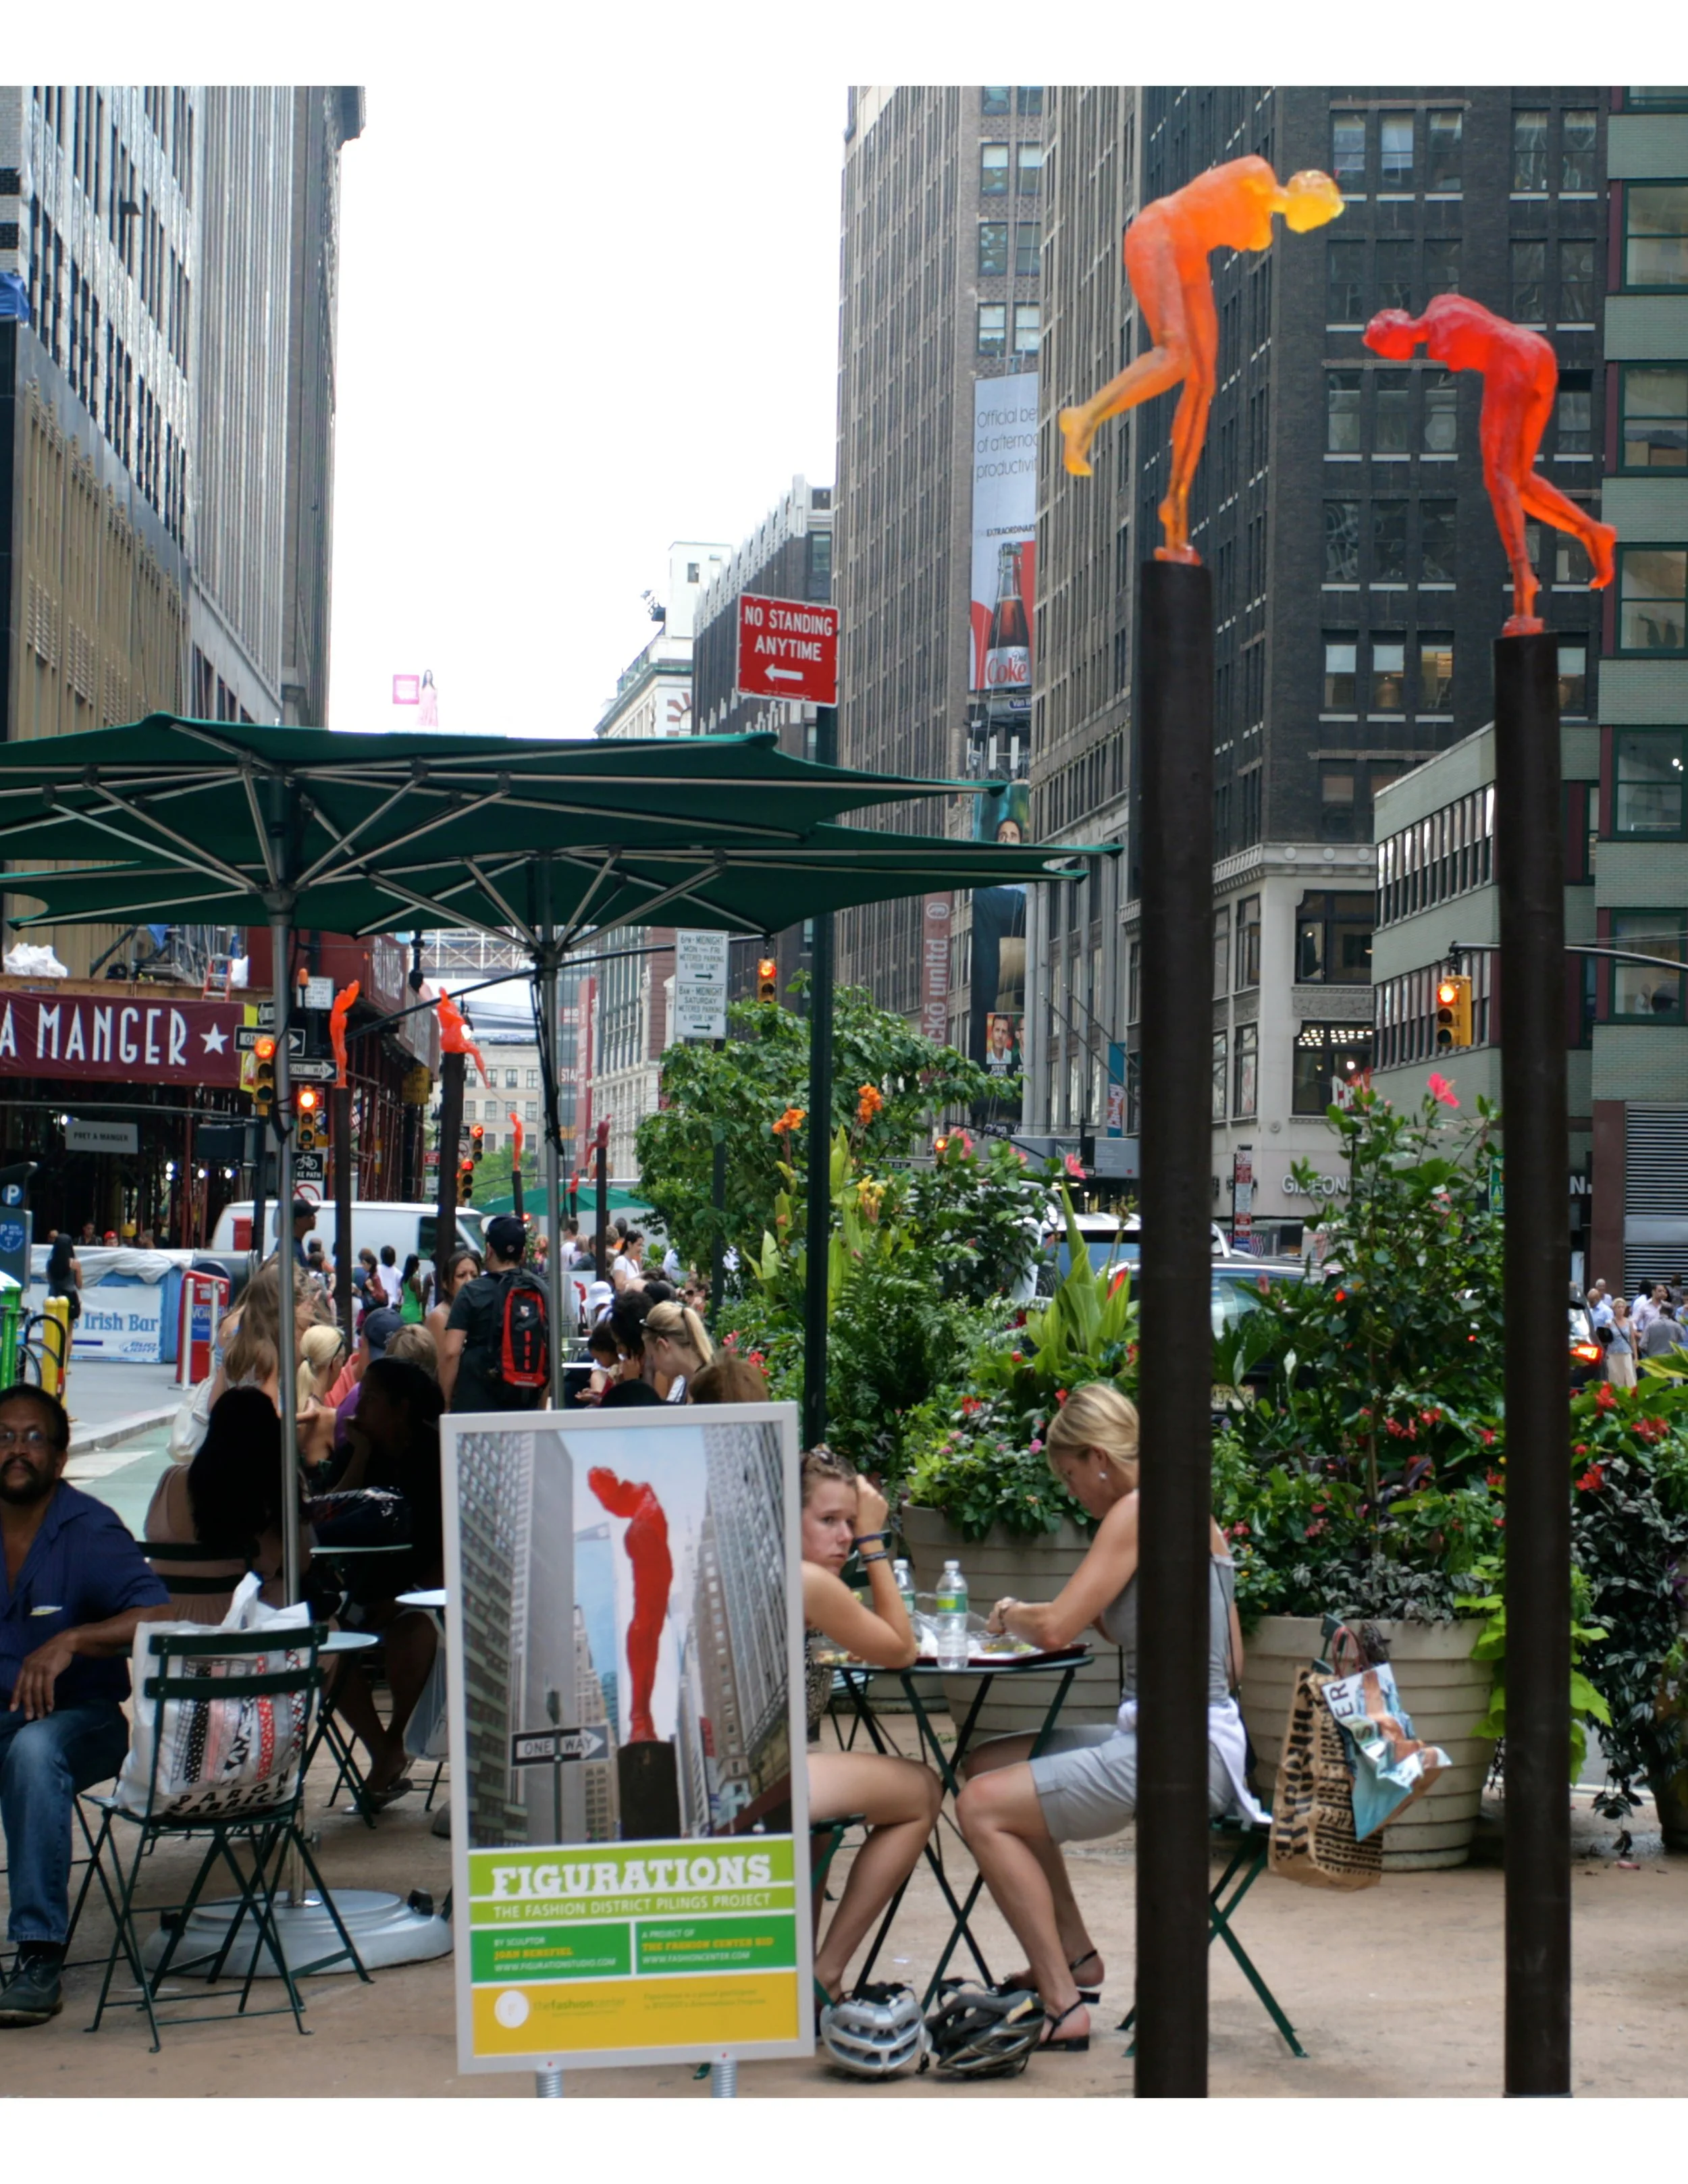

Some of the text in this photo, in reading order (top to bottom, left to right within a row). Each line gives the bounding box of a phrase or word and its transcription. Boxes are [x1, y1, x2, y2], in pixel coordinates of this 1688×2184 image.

[977, 406, 1038, 428] Official be
[977, 435, 989, 454] of
[976, 456, 1038, 483] productivi
[745, 605, 833, 637] NO STANDING
[754, 634, 822, 662] ANYTIME
[987, 655, 1028, 685] Coke
[695, 935, 724, 945] MIDNIGHT
[679, 953, 724, 963] METERED PARKING
[695, 986, 723, 996] MIDNIGHT
[679, 1005, 723, 1014] METERED PARKING
[684, 996, 717, 1005] SATURDAY
[0, 999, 188, 1066] A MANGER
[313, 1066, 329, 1074] WAY
[561, 1068, 580, 1083] STA
[74, 1131, 89, 1140] PRET
[100, 1134, 129, 1142] MANGER
[306, 1171, 321, 1179] PATH
[7, 1184, 20, 1205] P
[84, 1312, 124, 1331] Irish
[128, 1313, 159, 1332] Bar
[524, 1737, 593, 1755] ONE WAY
[179, 1768, 289, 1805] PARON
[492, 1854, 771, 1898] FIGURATIONS
[493, 1892, 771, 1919] THE FASHION DISTRICT PILINGS PROJECT
[494, 1936, 546, 1947] BY SCULPTOR
[641, 1929, 695, 1939] A PROJECT OF
[642, 1942, 663, 1952] THE
[666, 1940, 710, 1950] FASHION
[712, 1938, 753, 1948] CENTER
